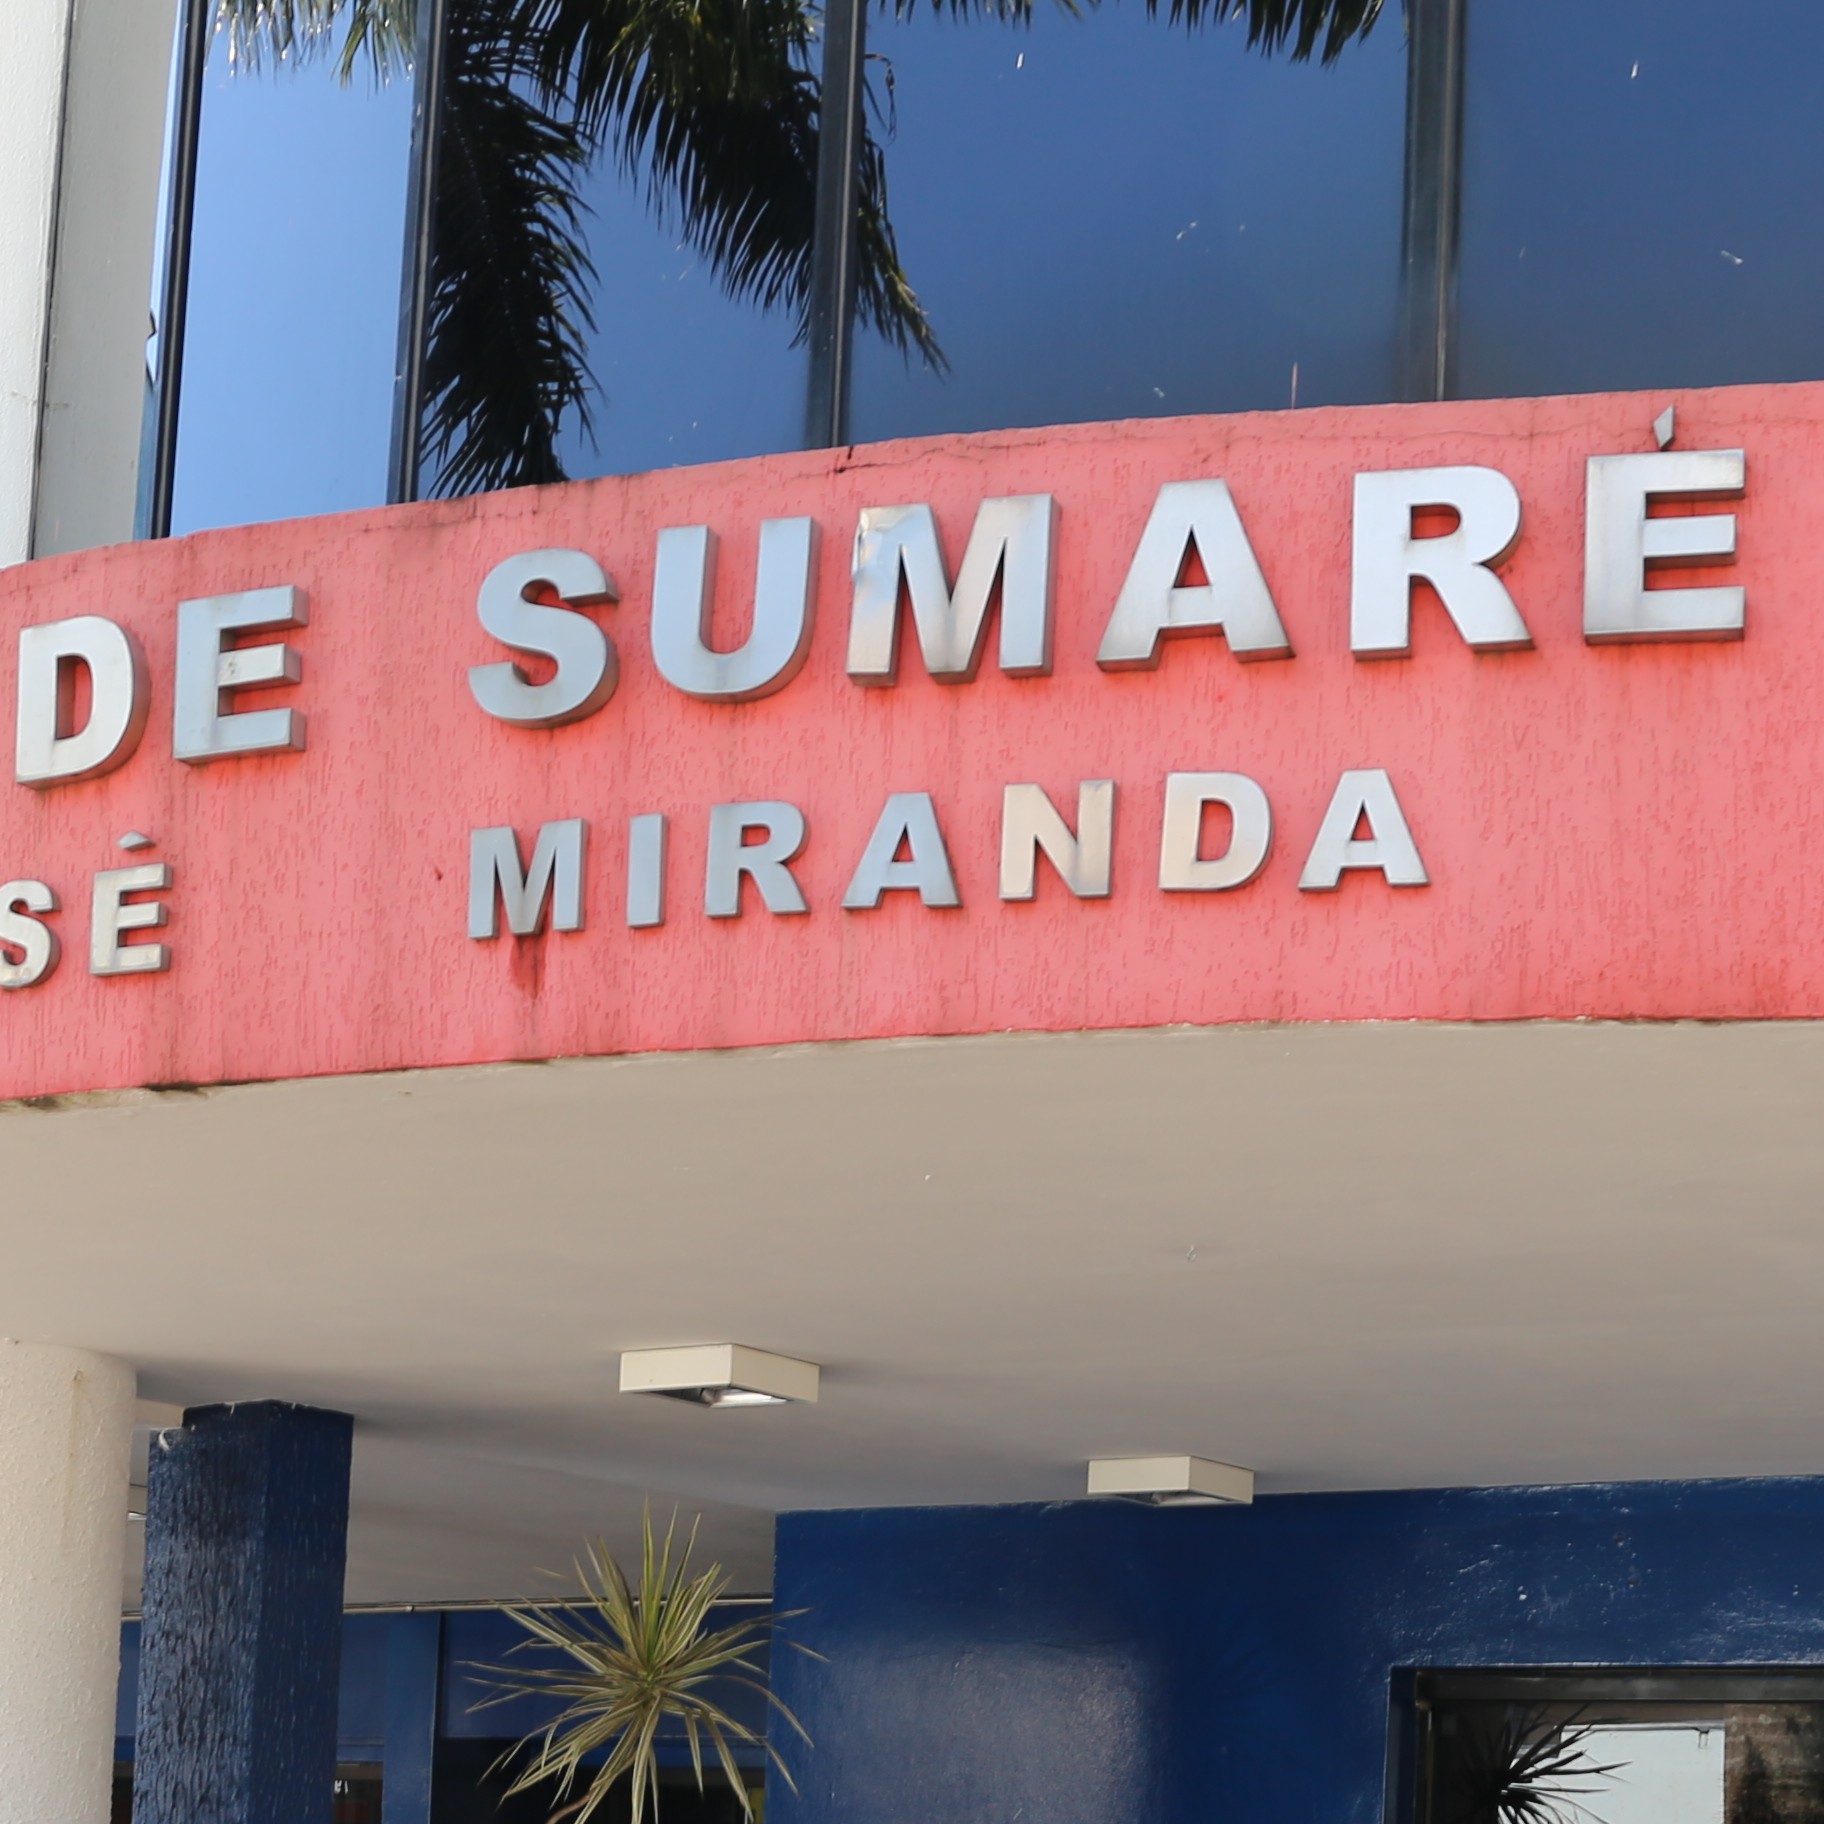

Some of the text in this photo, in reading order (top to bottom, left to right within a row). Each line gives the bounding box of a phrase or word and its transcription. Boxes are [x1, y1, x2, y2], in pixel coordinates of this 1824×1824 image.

[13, 584, 307, 791] DE
[466, 404, 1746, 728] SUMARÉ
[466, 768, 1429, 940] MIRANDA
